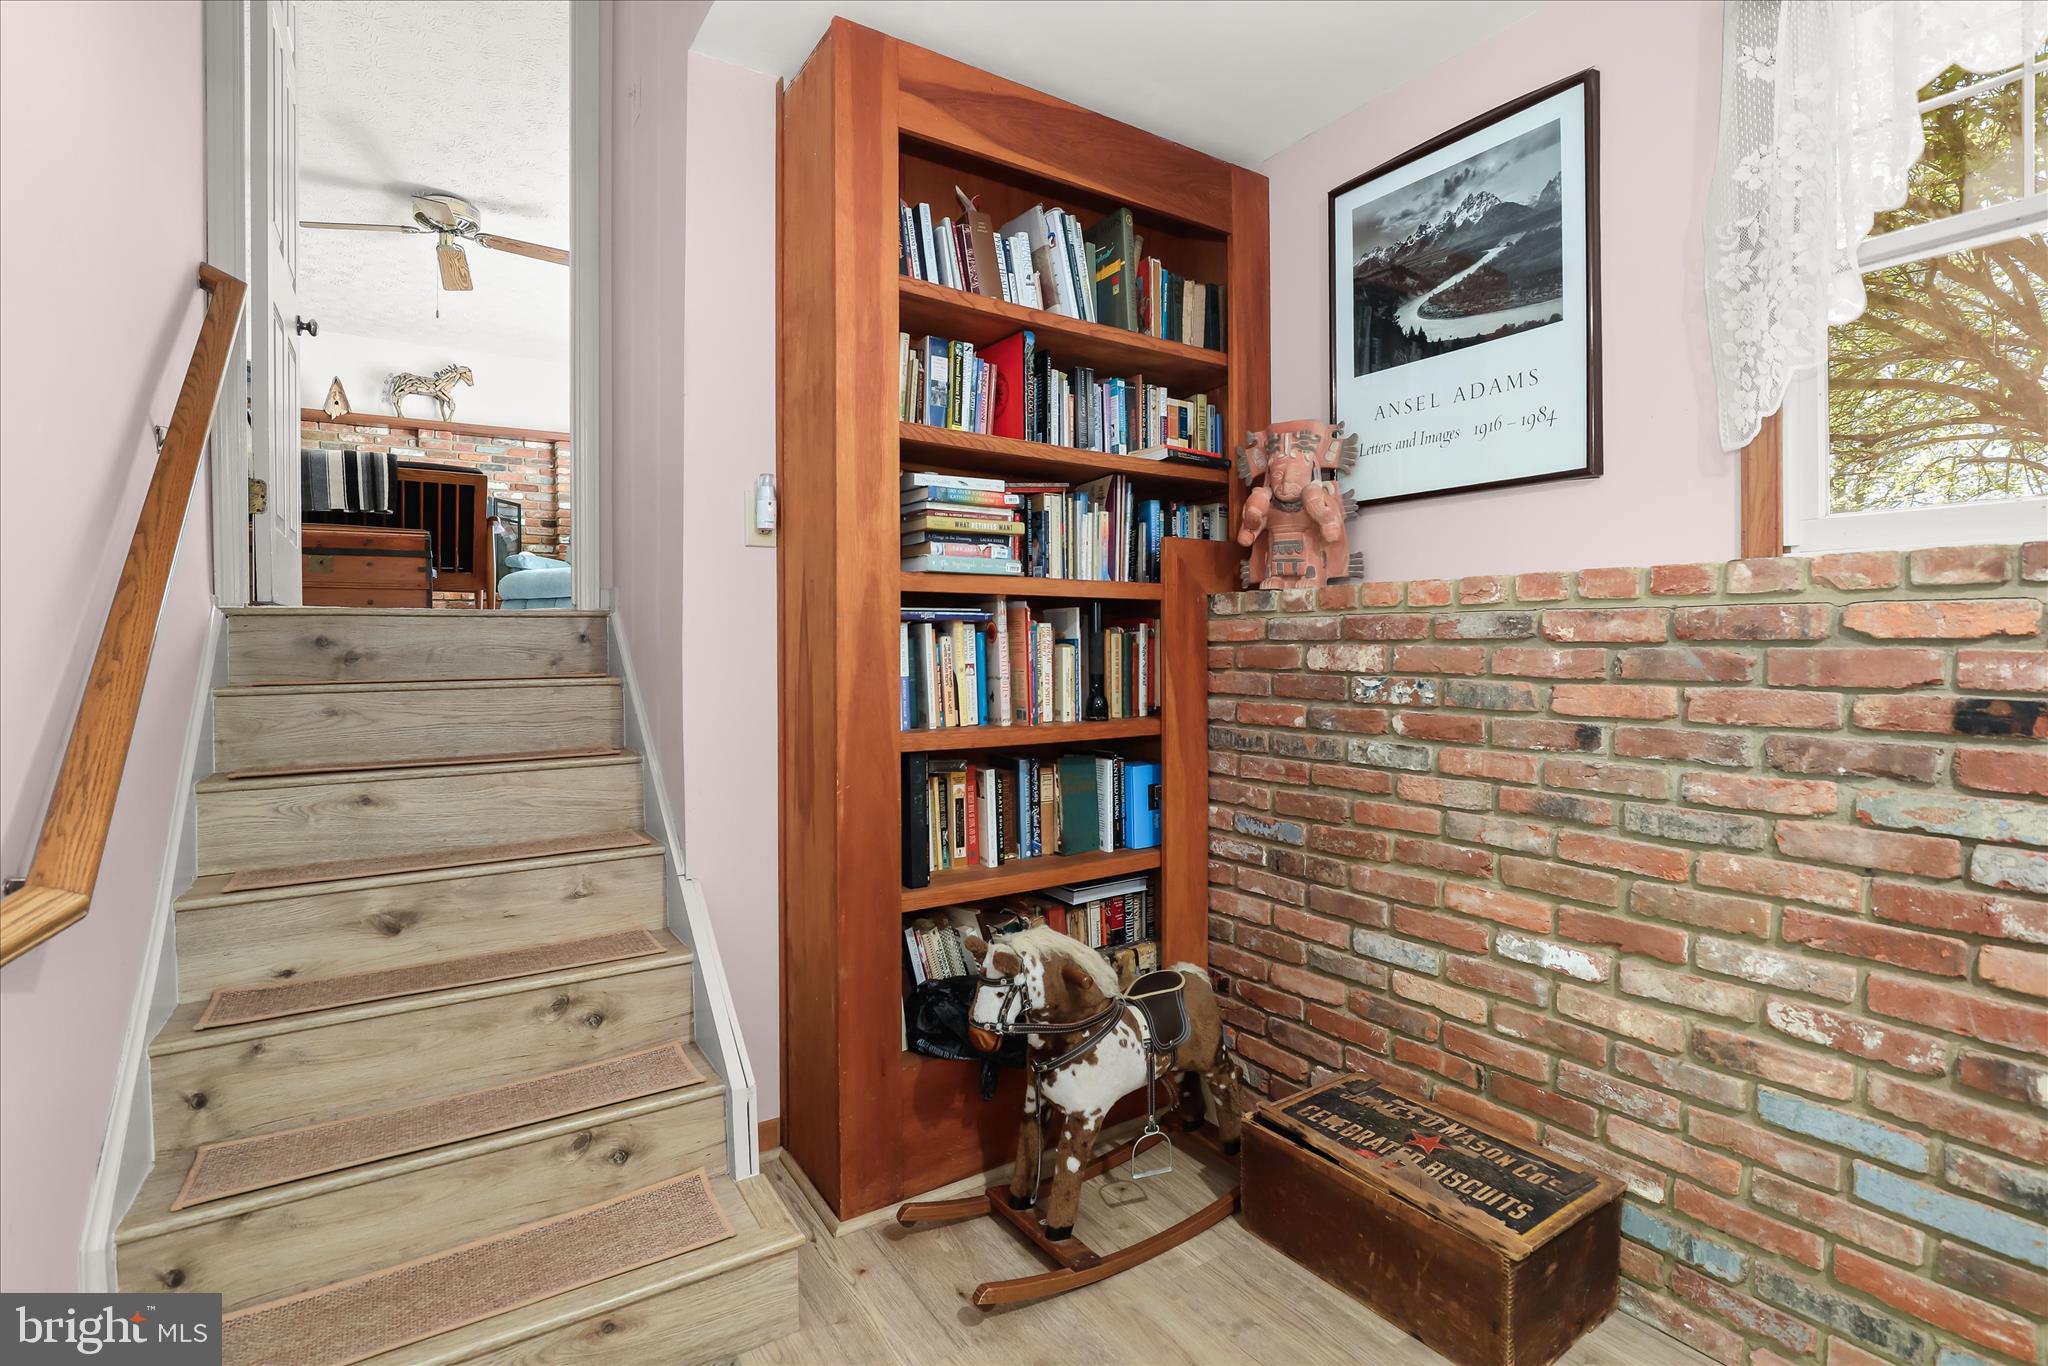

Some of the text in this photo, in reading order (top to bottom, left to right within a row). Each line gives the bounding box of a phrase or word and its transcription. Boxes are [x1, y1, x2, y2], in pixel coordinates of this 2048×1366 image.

[995, 236, 1004, 266] PERFECT
[1374, 368, 1540, 421] ANSEL ADAMS
[1359, 442, 1391, 457] Letters
[1395, 431, 1416, 450] and
[1420, 427, 1461, 448] Images
[1473, 417, 1502, 441] 1916
[1521, 405, 1559, 432] 1984
[954, 520, 969, 528] WHAT
[998, 523, 1013, 531] WANT
[1297, 1105, 1535, 1220] CELEBRATED BISCUITS
[1438, 1122, 1517, 1168] MASON
